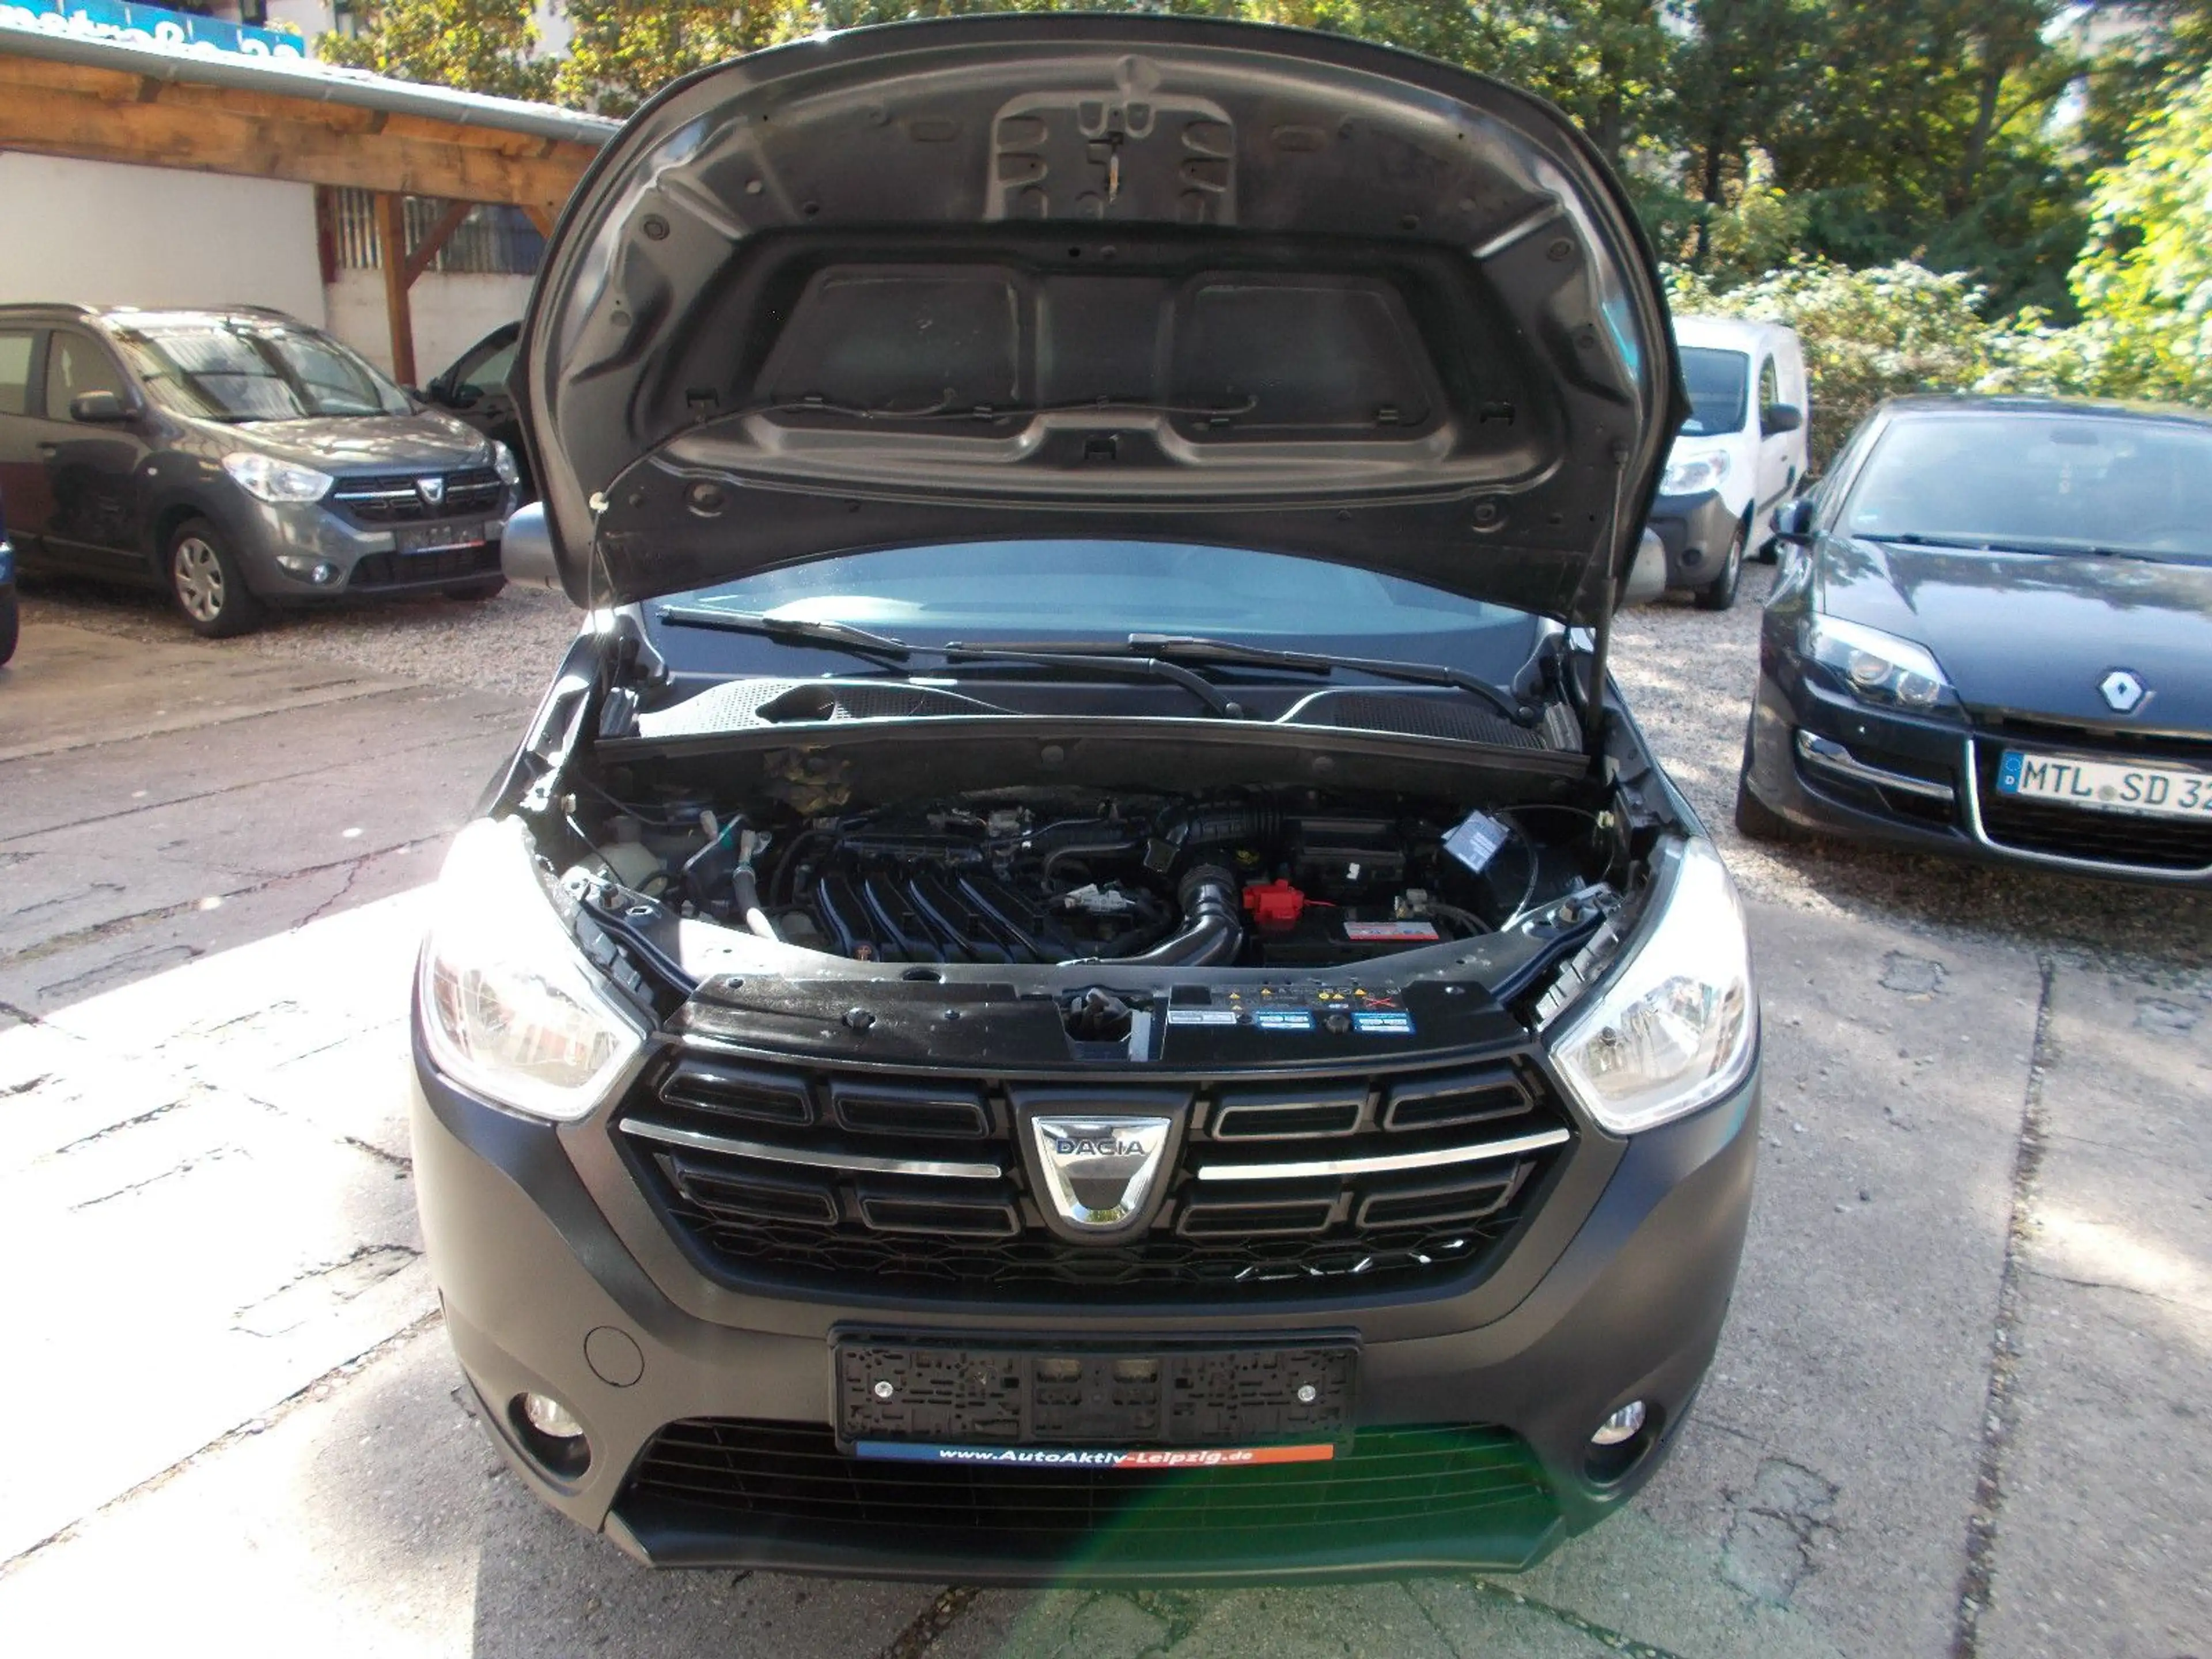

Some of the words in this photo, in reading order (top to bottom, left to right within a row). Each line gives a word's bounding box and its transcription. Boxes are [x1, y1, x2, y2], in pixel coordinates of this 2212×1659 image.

[2005, 775, 2015, 785] D
[2022, 760, 2093, 796] MTL
[2119, 772, 2169, 804] SD
[1056, 1137, 1146, 1156] DACIA
[939, 1449, 1253, 1465] www.AutoAktiv-Leipzig.de
